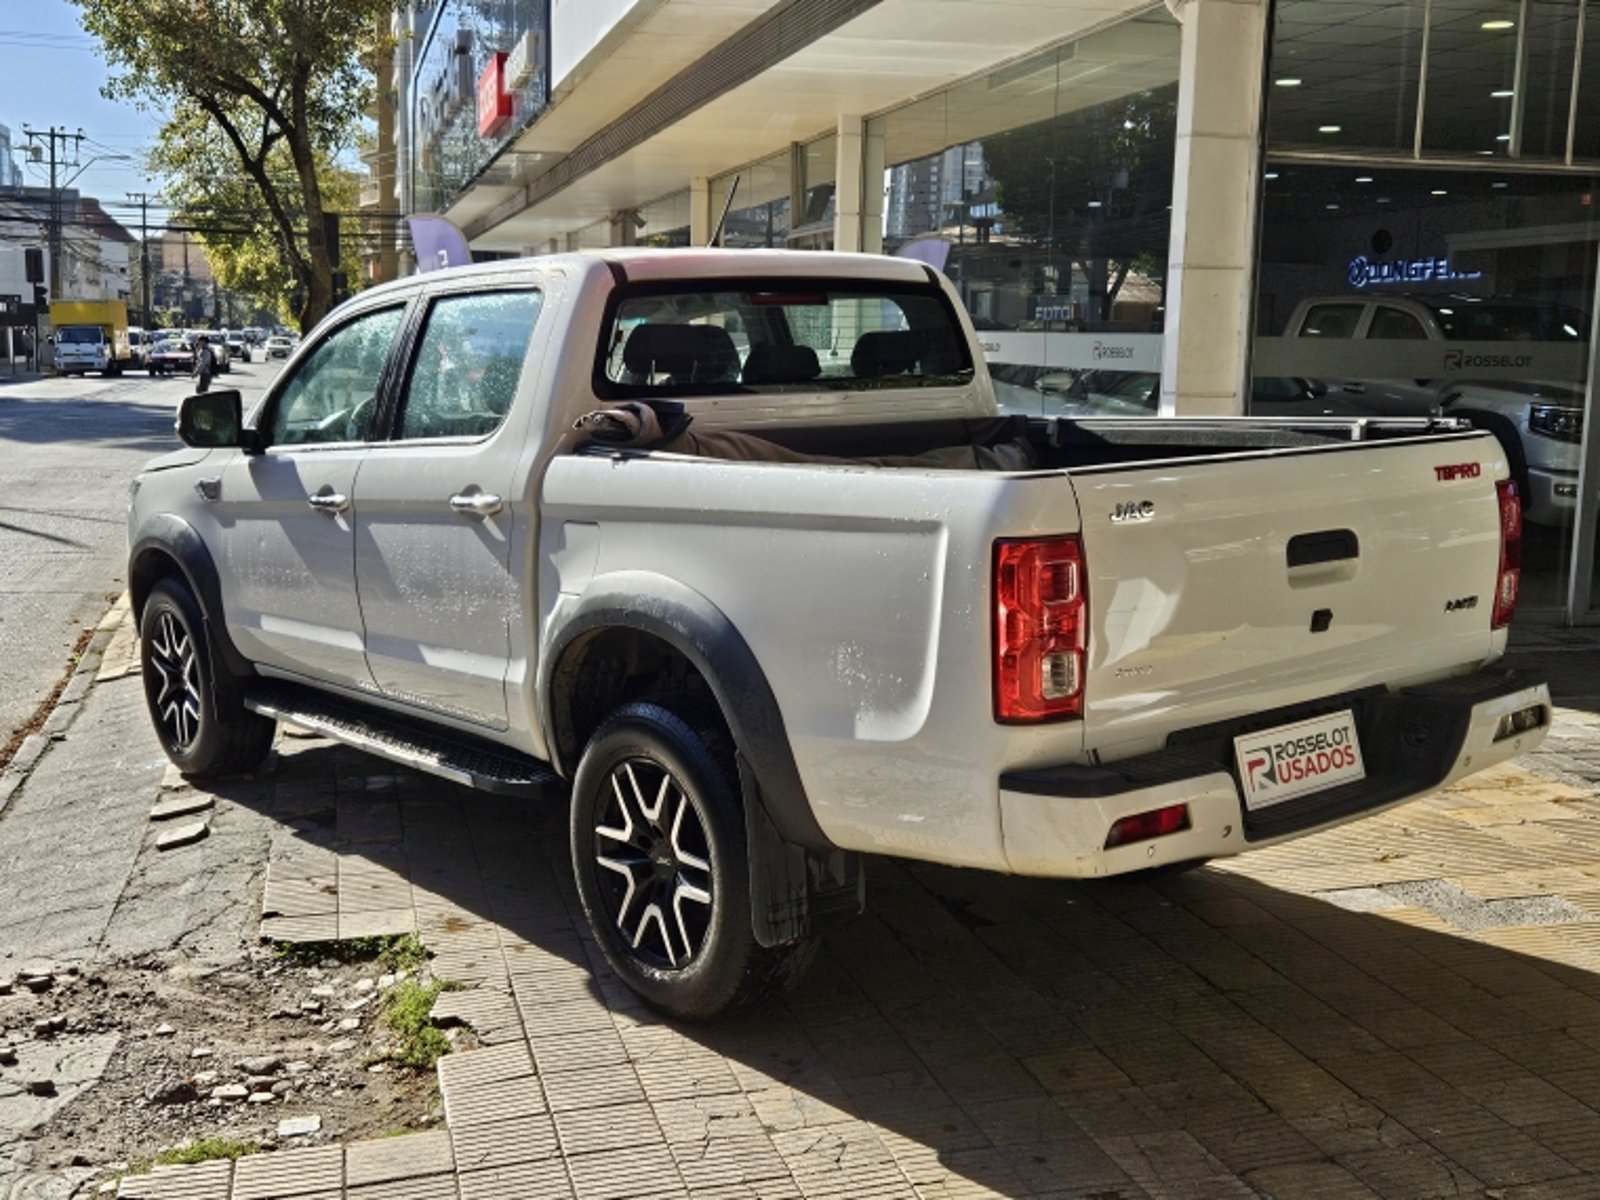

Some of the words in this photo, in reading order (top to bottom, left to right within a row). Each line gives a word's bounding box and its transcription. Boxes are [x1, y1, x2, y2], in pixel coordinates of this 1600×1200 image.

[1464, 354, 1533, 368] ROSSELOT
[1109, 500, 1155, 522] JAC
[1273, 726, 1350, 761] ROSSELOT
[1277, 744, 1357, 784] USADOS
